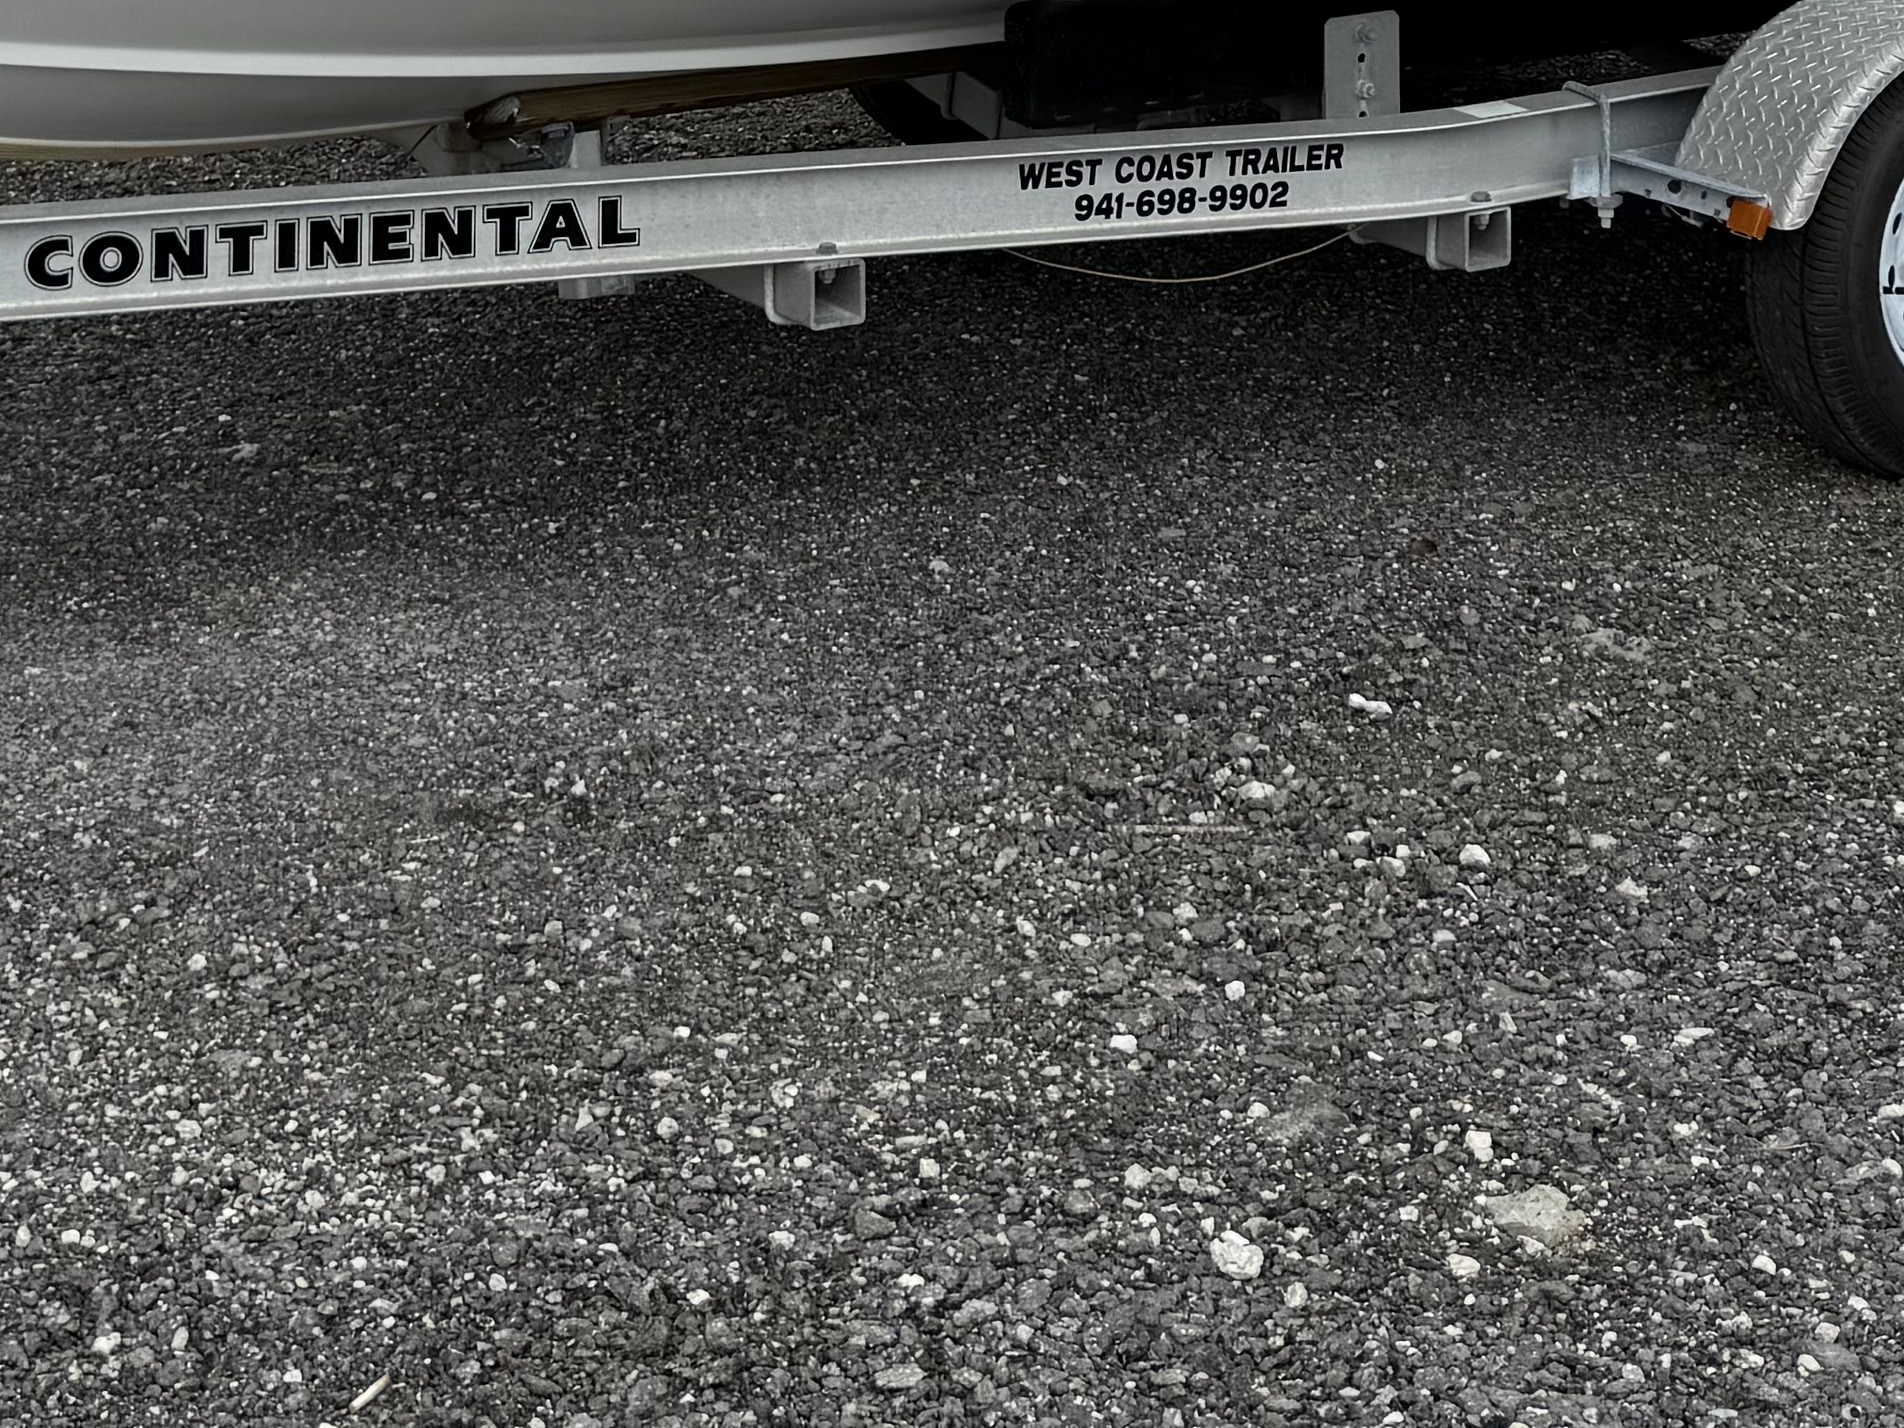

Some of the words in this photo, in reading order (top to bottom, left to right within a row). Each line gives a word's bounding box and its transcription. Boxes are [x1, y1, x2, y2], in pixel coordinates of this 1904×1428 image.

[1018, 158, 1103, 191] WEST
[1114, 151, 1214, 185] COAST
[1225, 143, 1345, 178] TRAILER
[1073, 180, 1290, 222] 941-698-9902
[23, 196, 641, 291] CONTINENTAL
